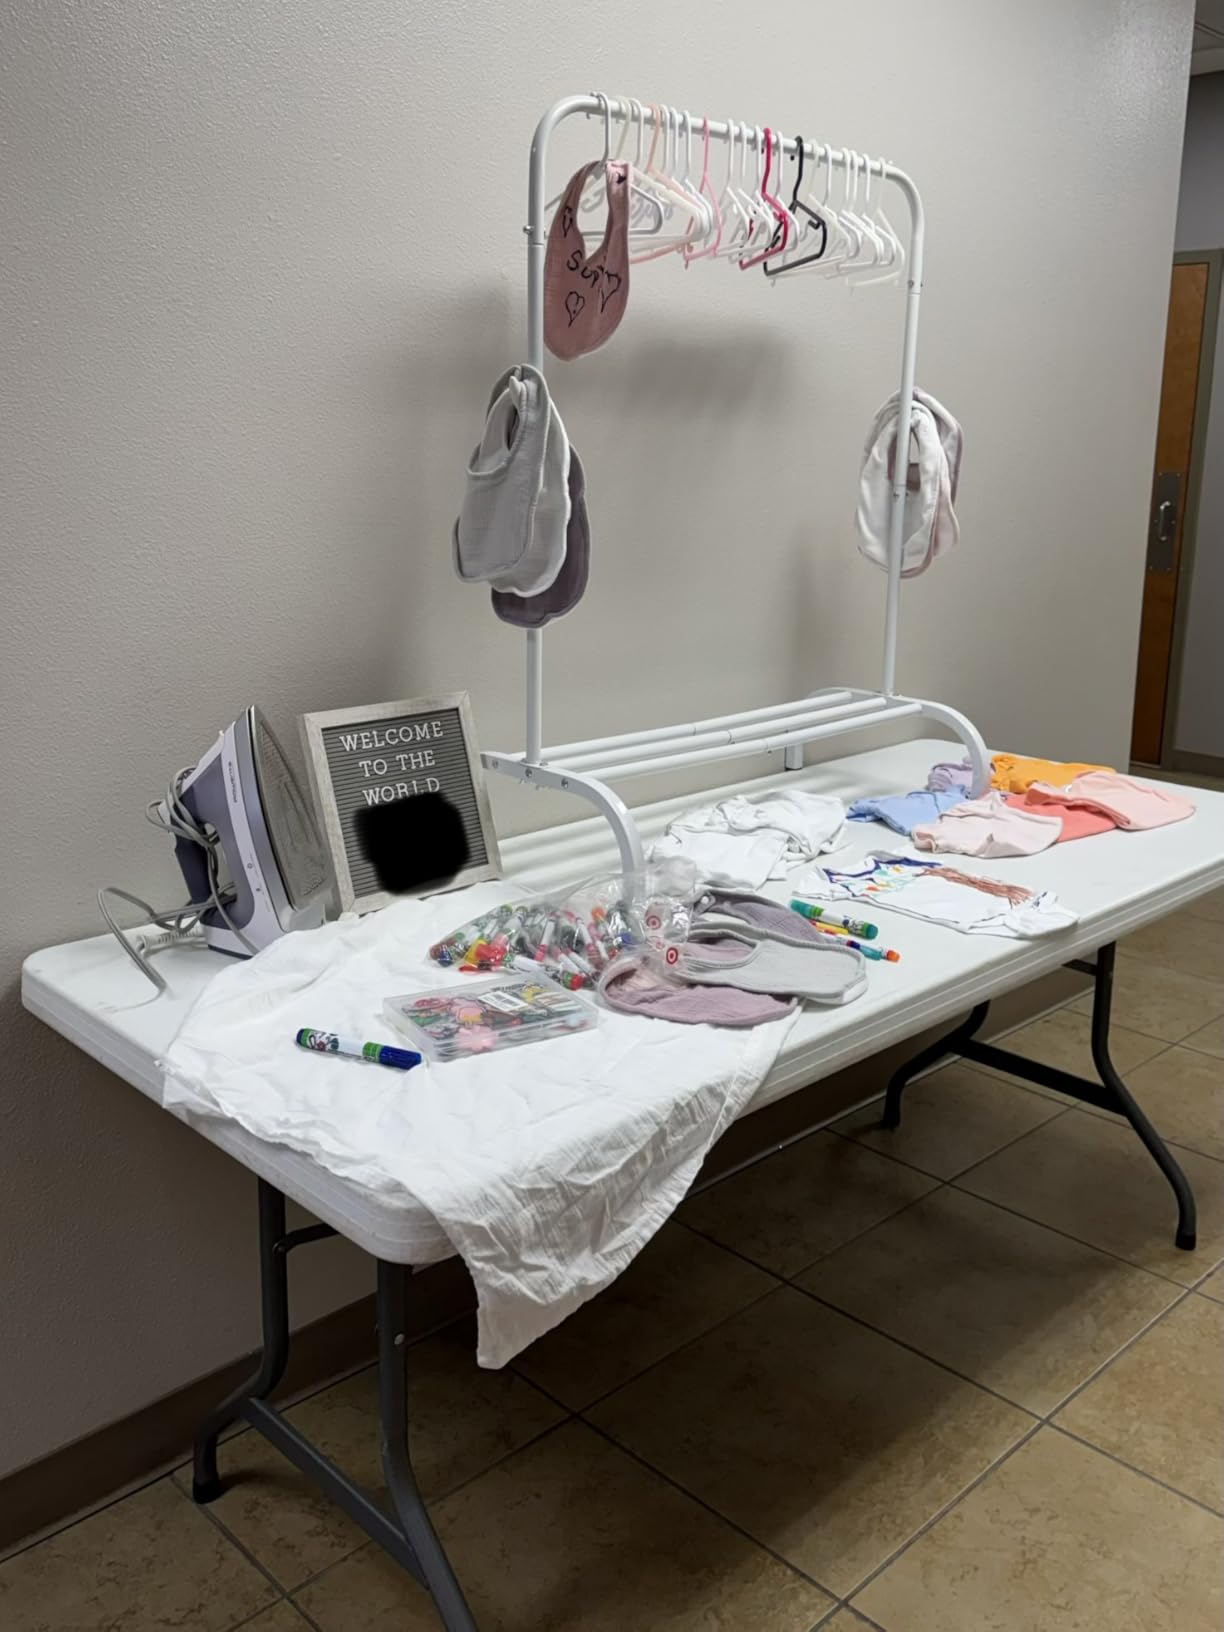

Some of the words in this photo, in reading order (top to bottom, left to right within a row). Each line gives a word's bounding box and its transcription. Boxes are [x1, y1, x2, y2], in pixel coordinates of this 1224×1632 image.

[339, 721, 444, 752] WELCOME
[359, 758, 388, 778] TO
[395, 750, 436, 771] THE
[362, 777, 440, 806] WORLD
